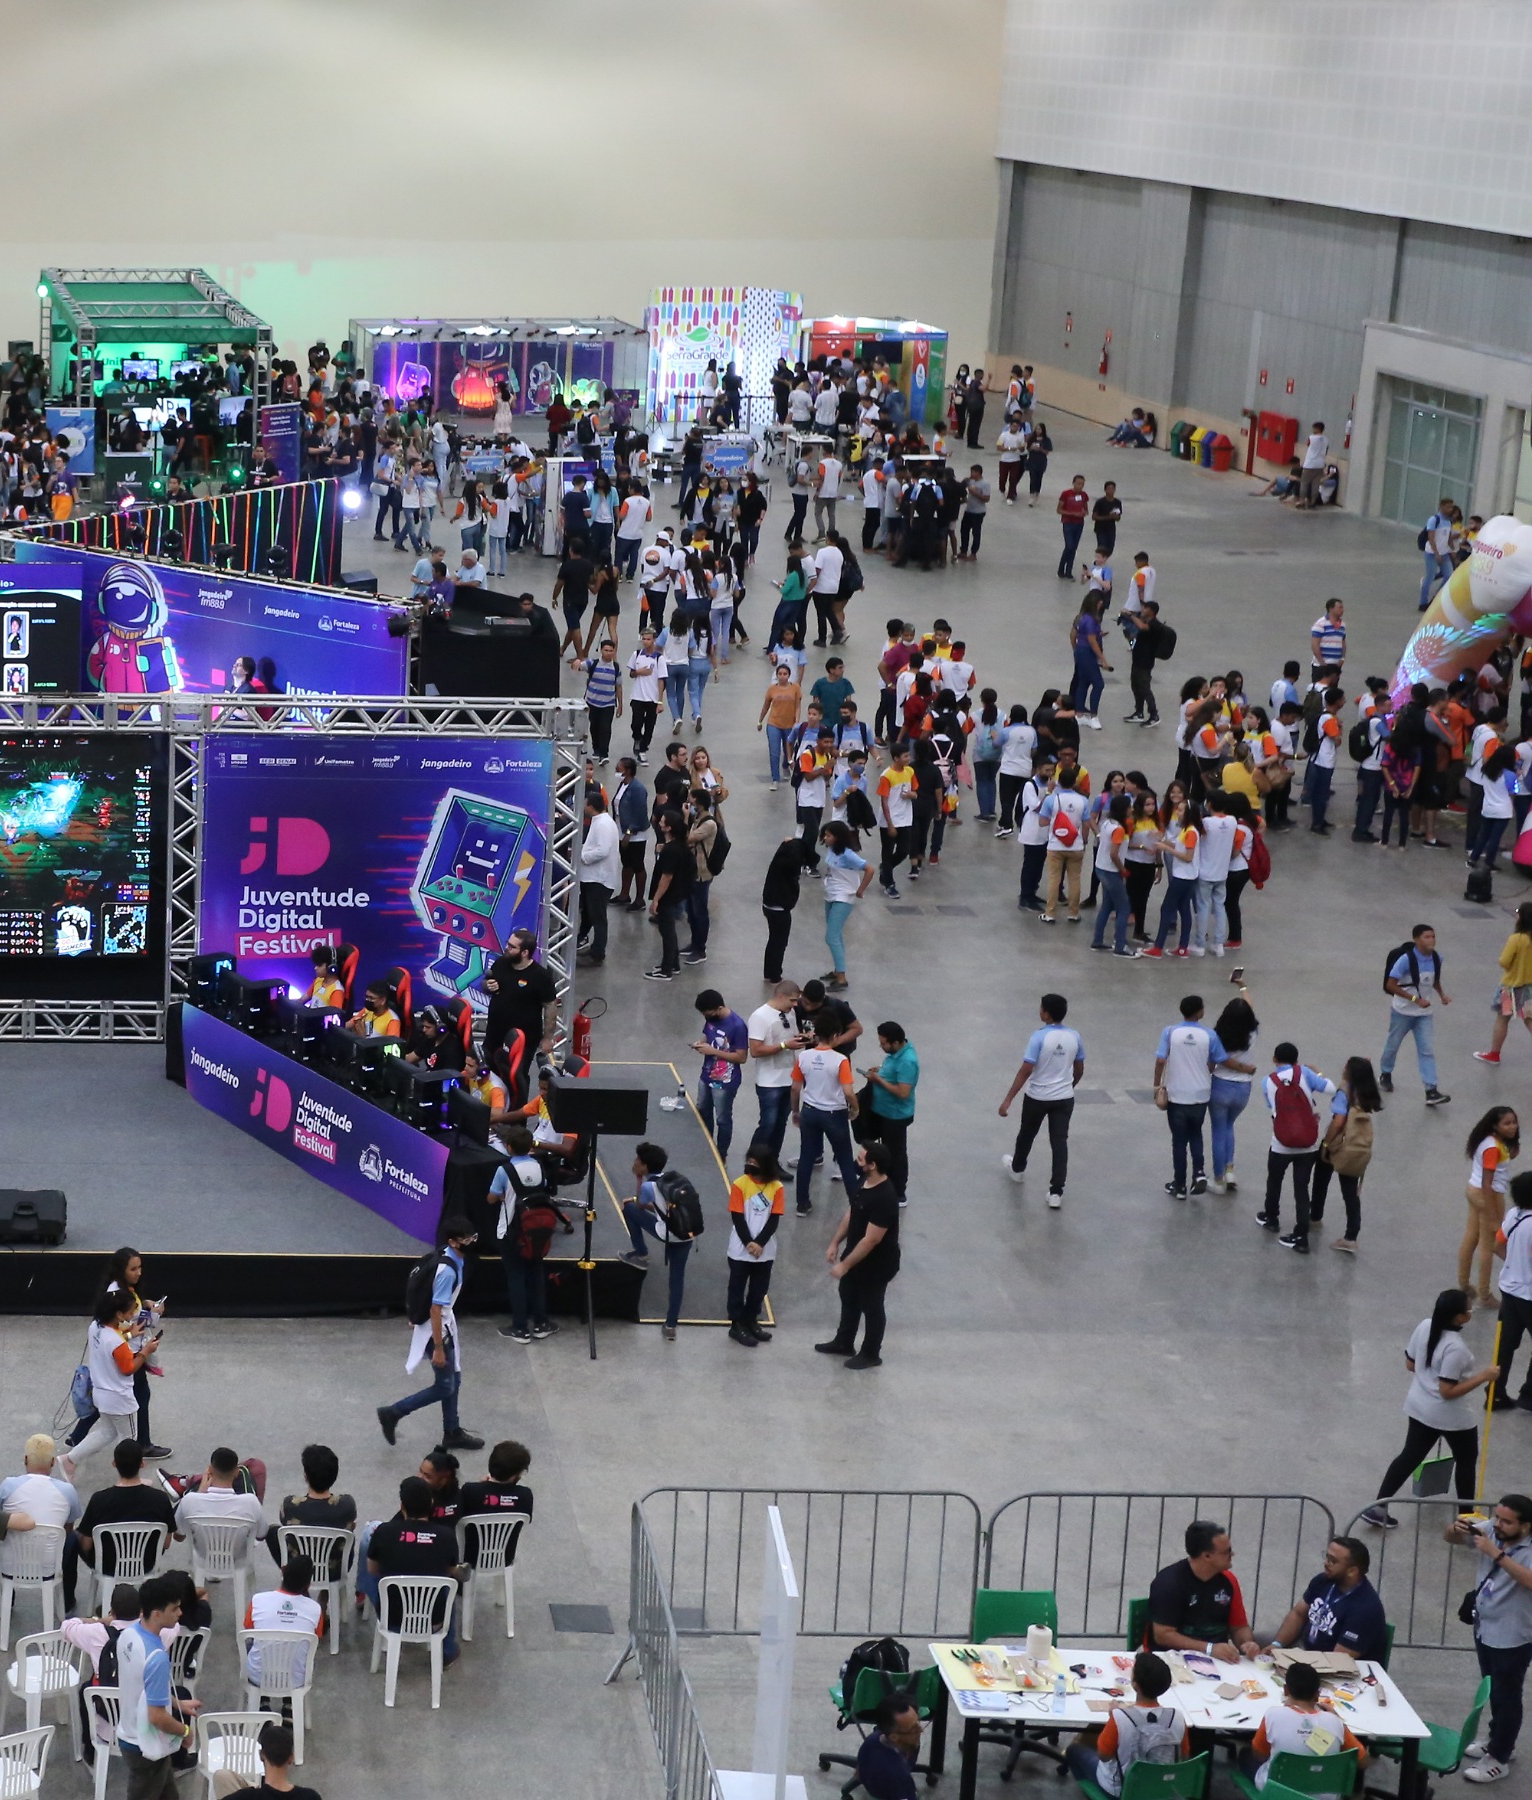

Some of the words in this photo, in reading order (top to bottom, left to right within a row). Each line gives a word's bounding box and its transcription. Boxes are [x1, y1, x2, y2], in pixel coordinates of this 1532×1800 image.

[420, 758, 471, 770] jangadeiro
[505, 759, 542, 768] Fortaleza
[239, 886, 370, 908] Juventude
[238, 908, 324, 934] Digital
[190, 1046, 240, 1088] jangadeiro
[295, 1107, 331, 1140] Digital
[298, 1091, 353, 1133] Juventude
[294, 1128, 334, 1160] Festival
[384, 1158, 429, 1196] Fortaleza
[389, 1180, 421, 1202] PREFEITURA
